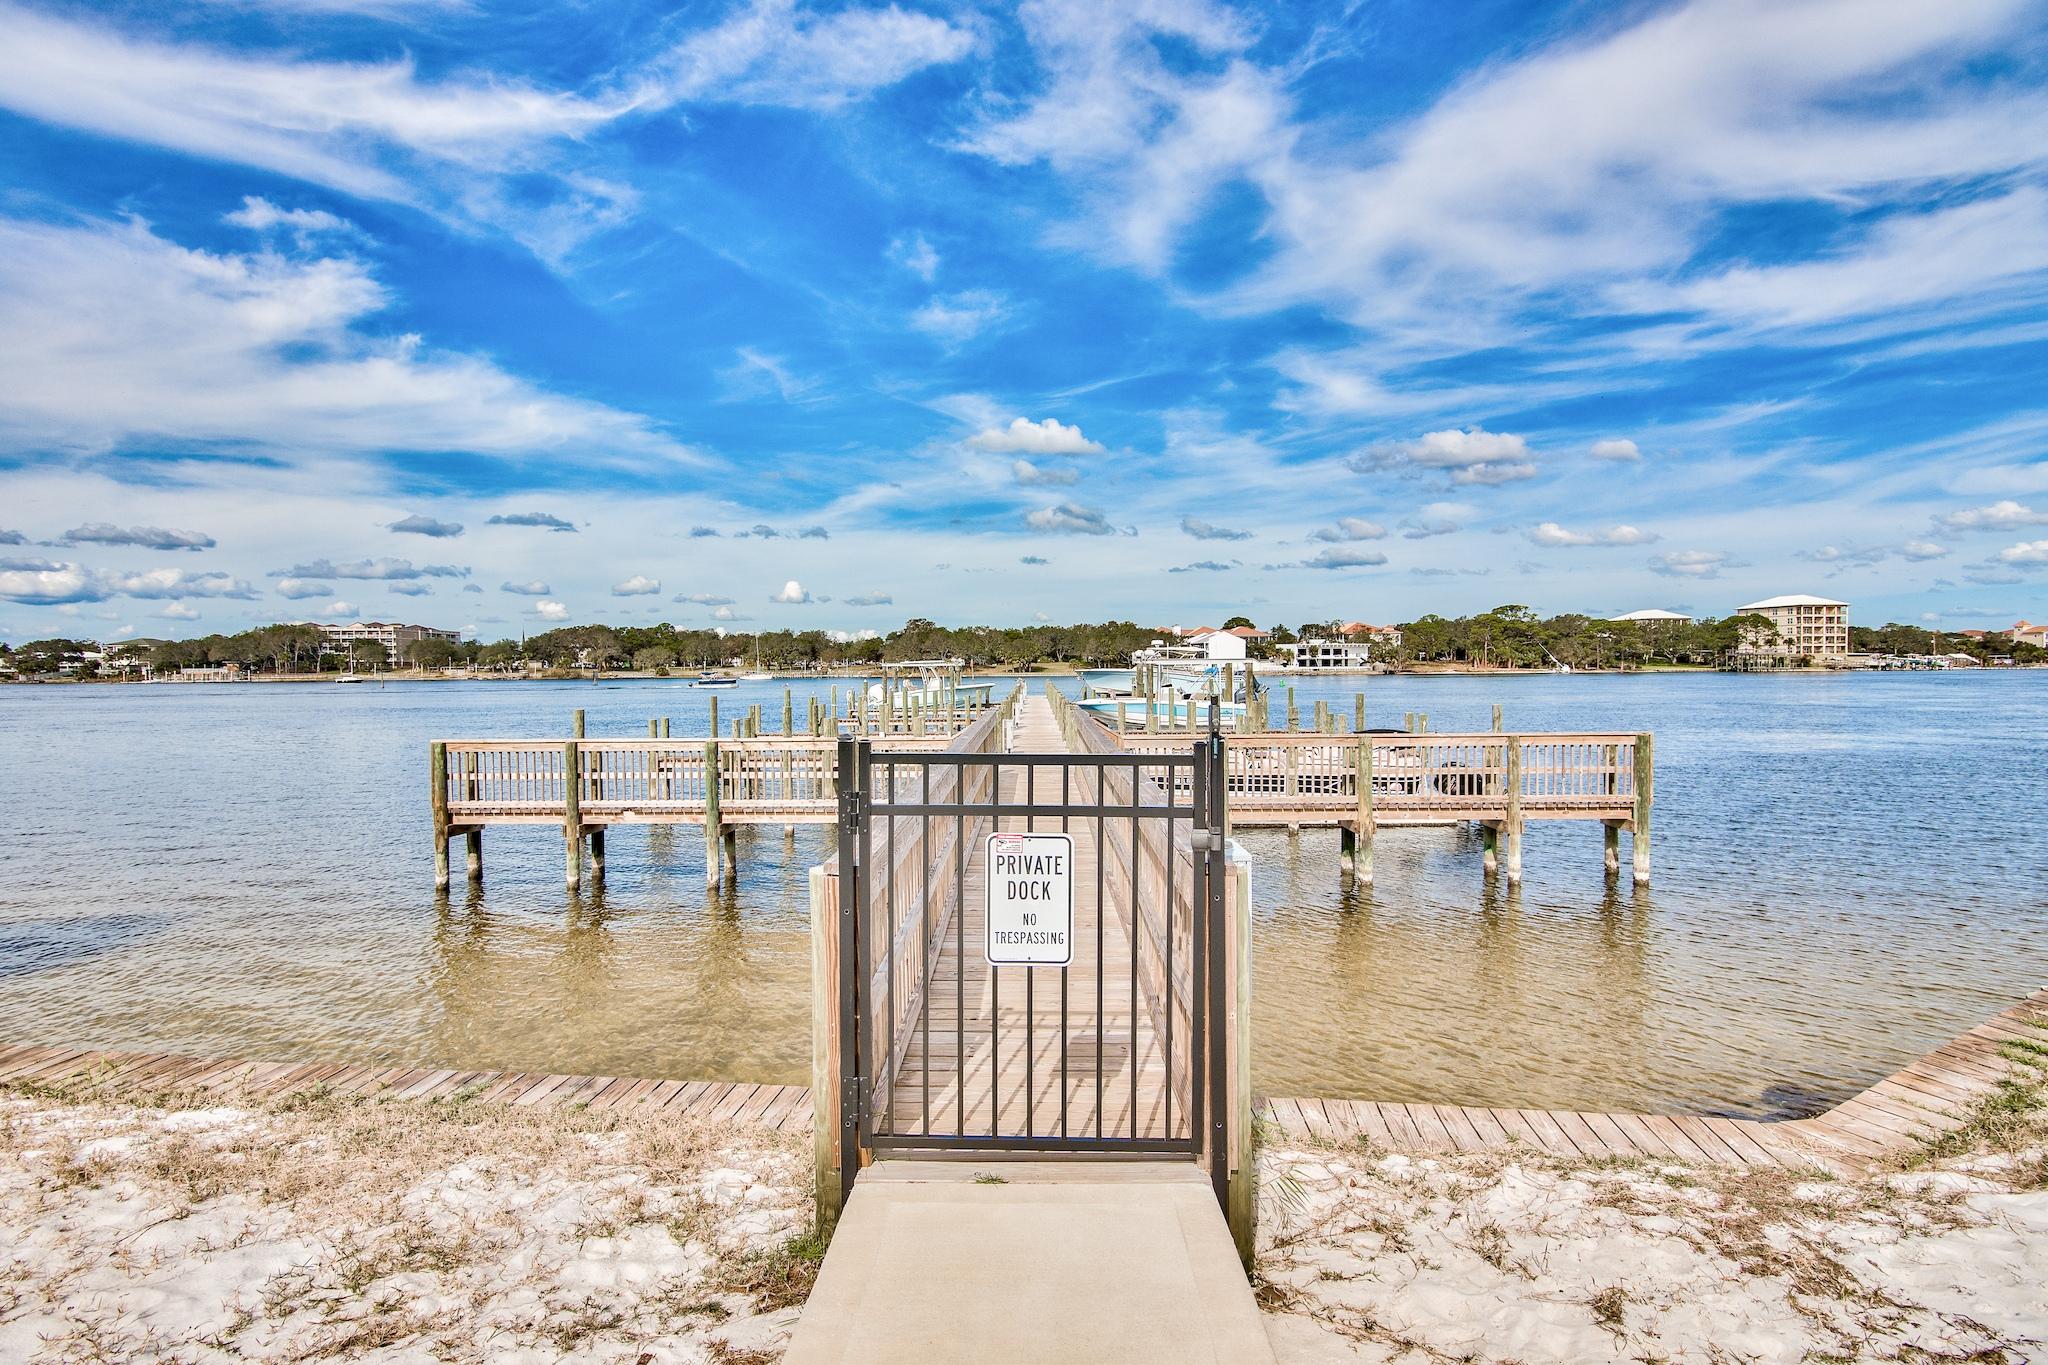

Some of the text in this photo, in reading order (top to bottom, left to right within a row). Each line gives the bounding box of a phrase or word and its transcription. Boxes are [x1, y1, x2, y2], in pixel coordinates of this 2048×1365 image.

[996, 855, 1063, 875] PRIVATE
[1007, 881, 1051, 900] DOCK
[1023, 913, 1037, 925] NO
[995, 931, 1064, 944] TRESPASSING
